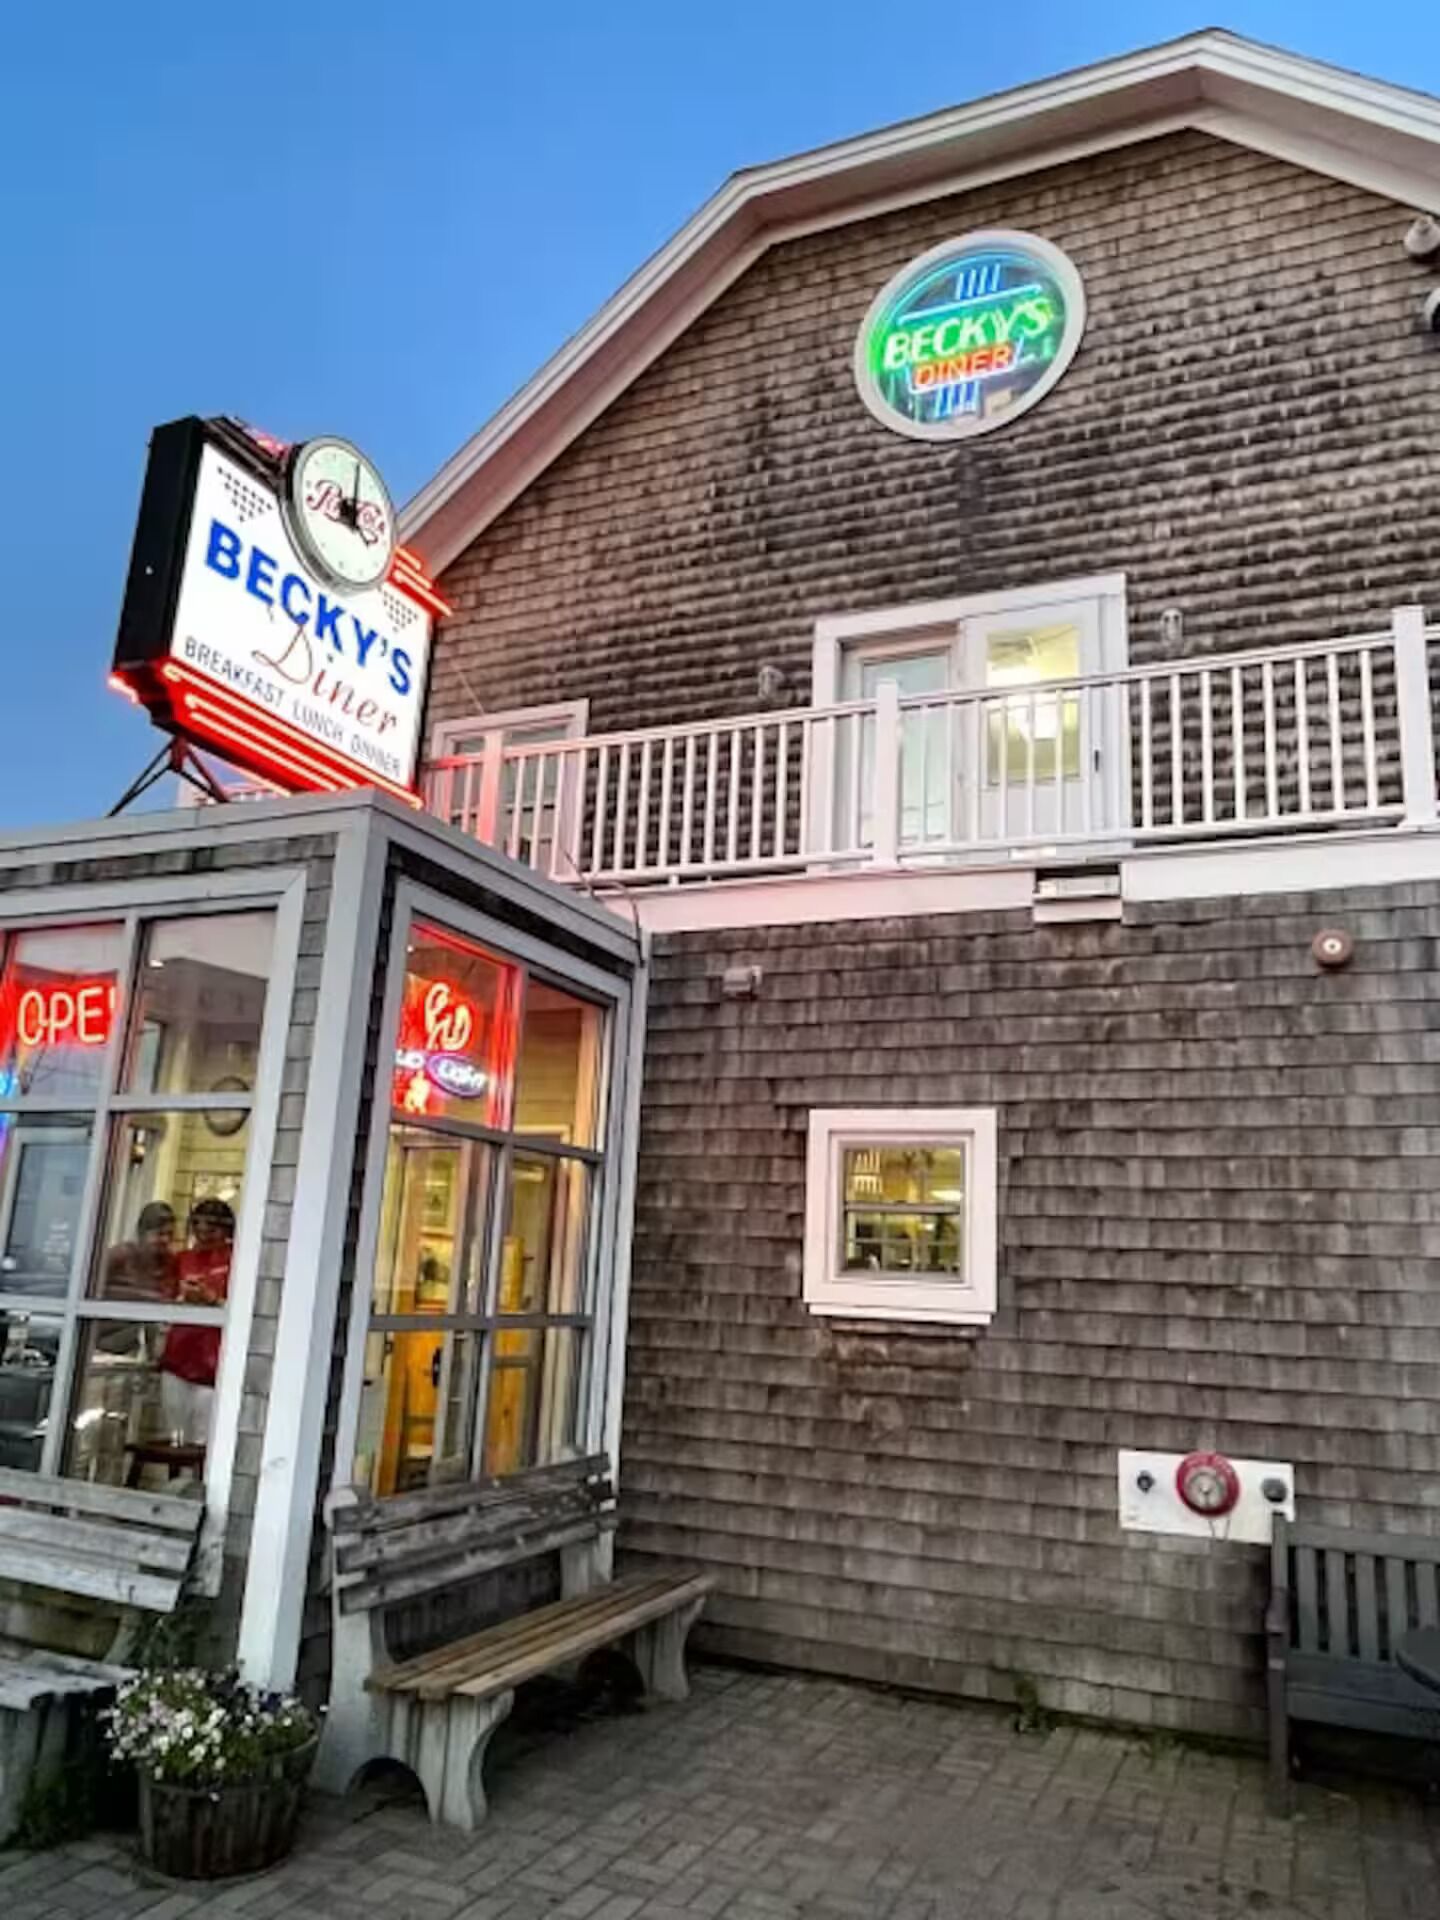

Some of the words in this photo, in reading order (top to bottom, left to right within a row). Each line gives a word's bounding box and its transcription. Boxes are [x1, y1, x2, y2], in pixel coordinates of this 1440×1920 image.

[914, 345, 1013, 389] DINER
[203, 519, 411, 696] BECKY'S
[185, 635, 285, 708] BREAKFAST
[292, 700, 344, 743] LUNCH
[349, 733, 401, 779] DINNER
[251, 618, 399, 734] Diner
[17, 986, 117, 1046] OPE
